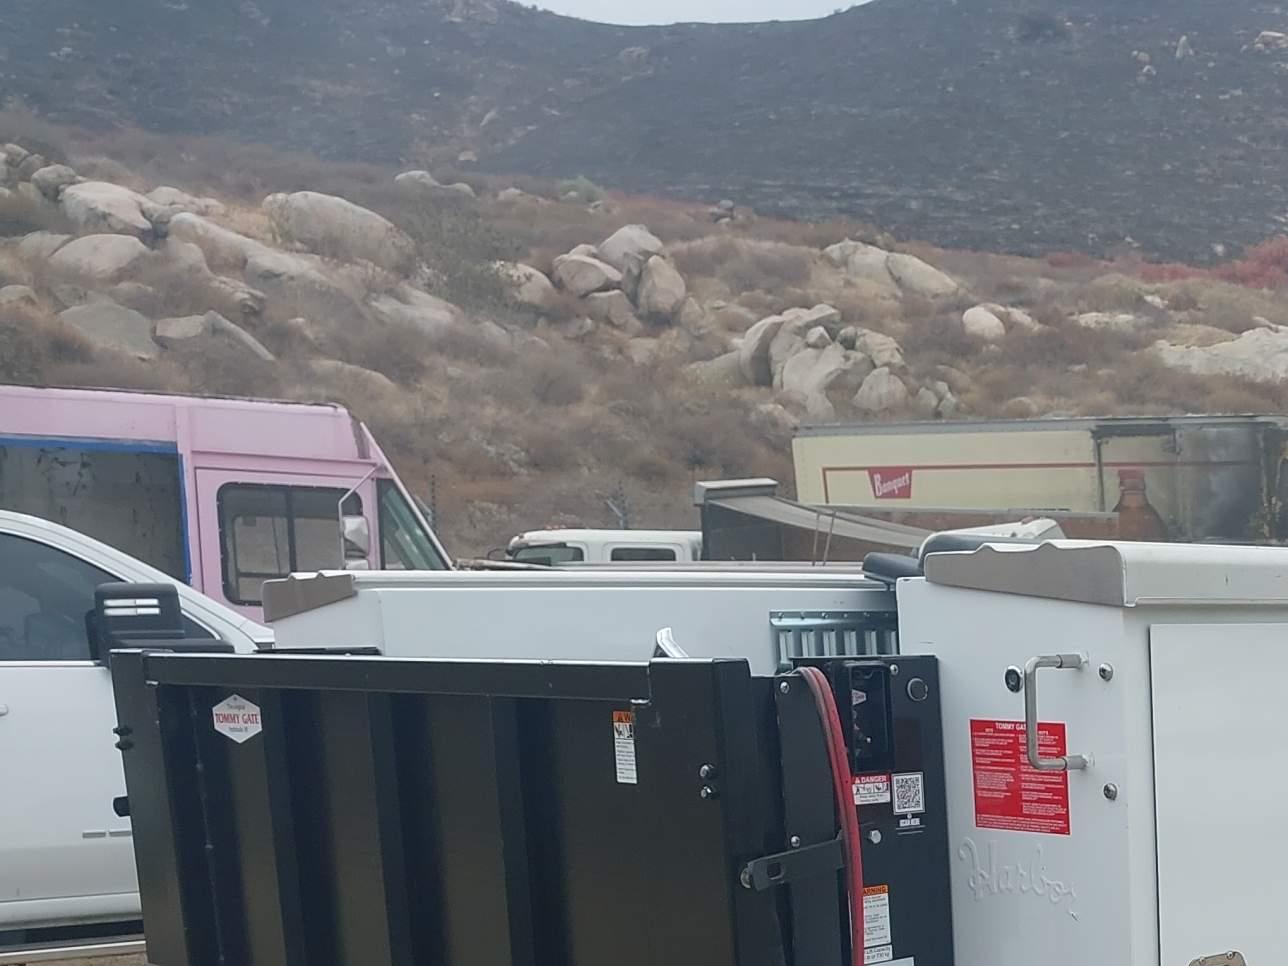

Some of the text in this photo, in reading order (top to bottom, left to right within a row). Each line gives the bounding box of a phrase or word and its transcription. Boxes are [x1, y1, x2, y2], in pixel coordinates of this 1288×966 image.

[873, 472, 909, 497] Banquet
[215, 712, 260, 725] TOMMY GATE
[995, 722, 1014, 730] TOMMY
[861, 775, 887, 783] DANGER
[863, 886, 888, 896] ARNING
